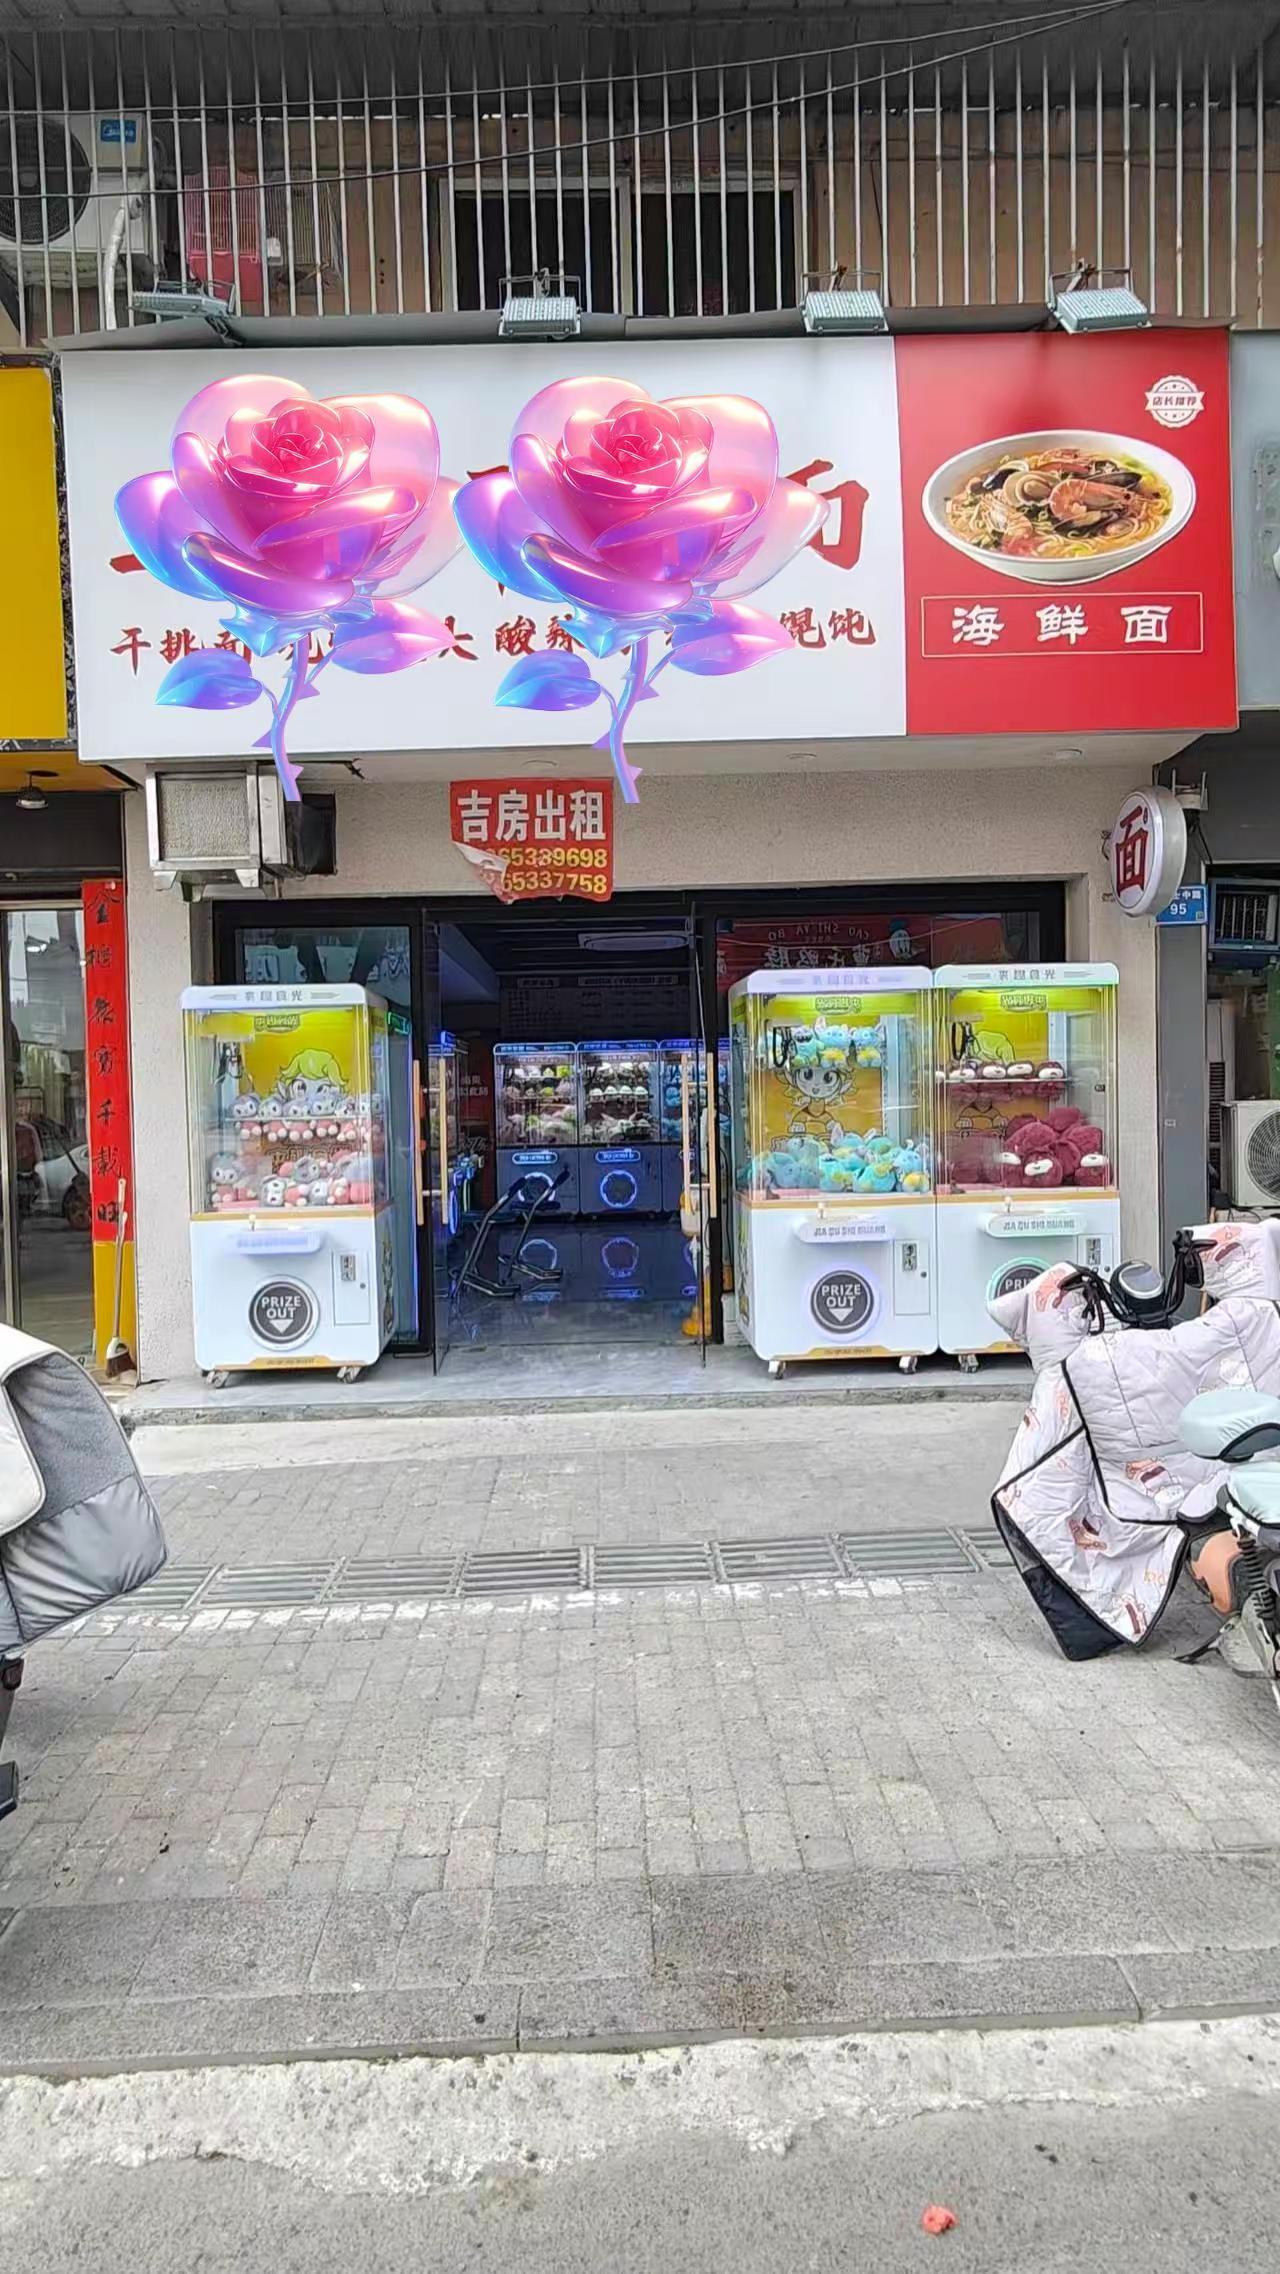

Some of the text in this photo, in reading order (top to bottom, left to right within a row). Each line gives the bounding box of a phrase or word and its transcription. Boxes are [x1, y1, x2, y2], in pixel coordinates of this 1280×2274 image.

[1152, 396, 1198, 407] 店长推荐
[952, 604, 1172, 646] 海鲜面
[457, 788, 607, 842] 吉房出租
[1116, 805, 1148, 897] 面
[1170, 903, 1187, 915] 95
[821, 1283, 862, 1297] PRIZE
[1005, 1278, 1031, 1291] PRI
[261, 1295, 302, 1309] PRIZE
[826, 1296, 856, 1308] OUT
[266, 1307, 297, 1319] OUT
